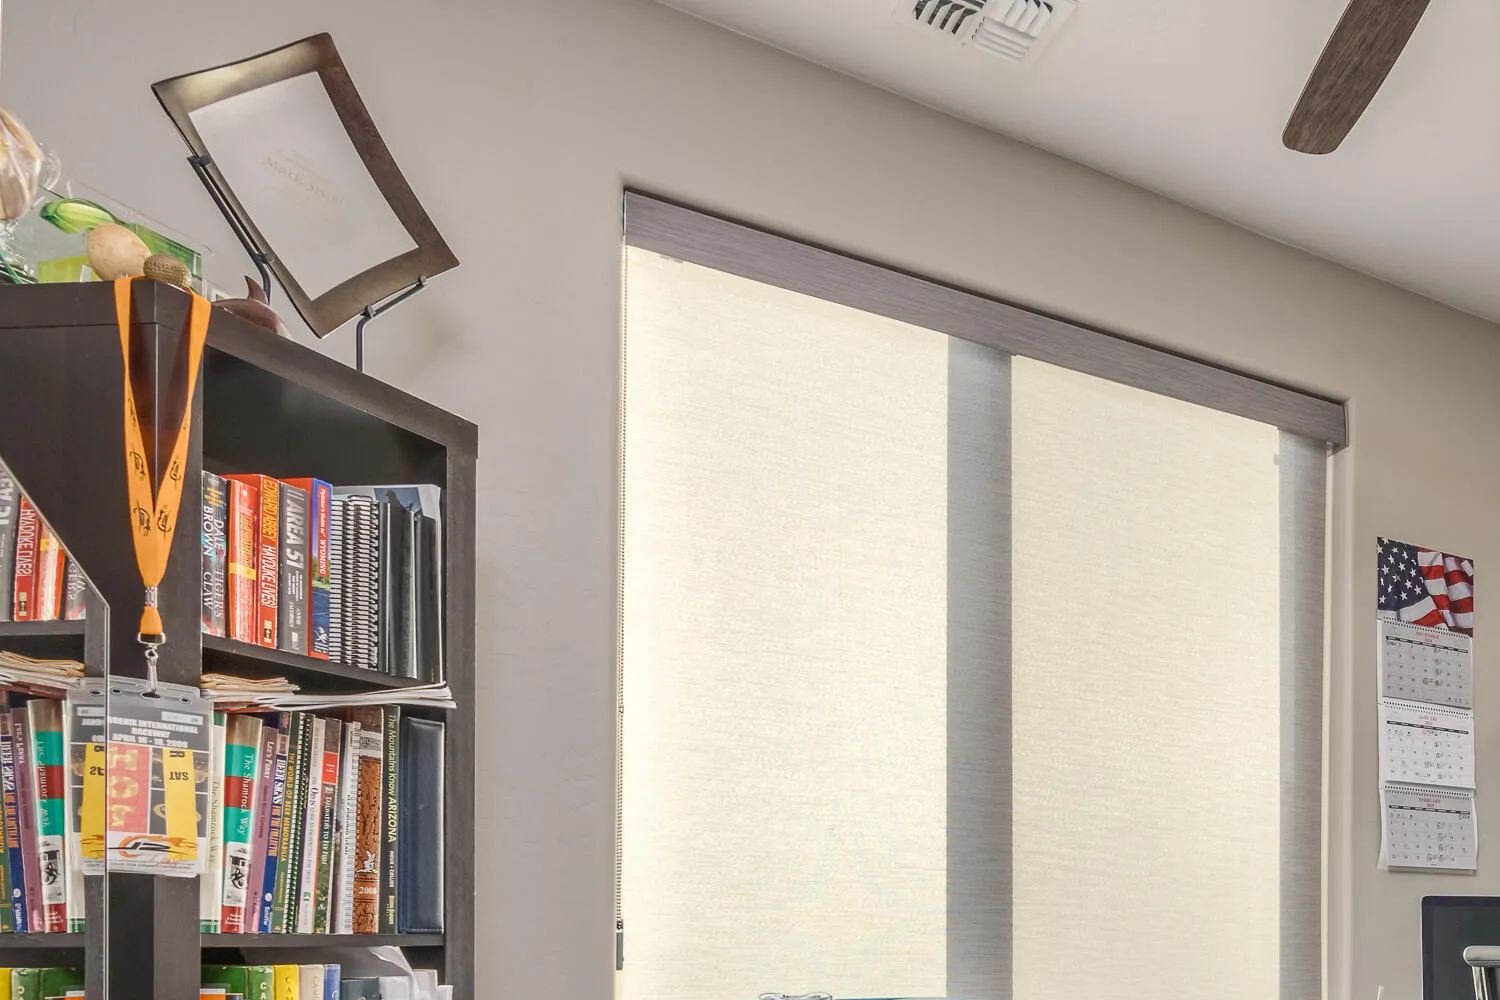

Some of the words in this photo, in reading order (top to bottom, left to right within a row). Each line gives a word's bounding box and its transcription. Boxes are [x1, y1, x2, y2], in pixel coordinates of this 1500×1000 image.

[263, 479, 277, 514] EDWARD
[203, 506, 214, 556] BROWN
[214, 519, 224, 550] DALE
[263, 515, 277, 542] ABBEY
[286, 499, 304, 545] AREA
[261, 544, 277, 583] HAYDUKE
[286, 547, 304, 569] 51
[203, 571, 214, 609] CLAW
[261, 582, 277, 608] LIVES!
[388, 714, 396, 729] The
[243, 754, 253, 769] The
[388, 729, 396, 772] Mountains
[168, 771, 189, 781] SAT
[275, 759, 286, 780] BEER
[240, 772, 252, 813] Shamrock
[272, 781, 285, 804] SIGNS
[388, 772, 396, 796] Know
[237, 818, 249, 835] Way
[387, 796, 397, 843] ARIZONA
